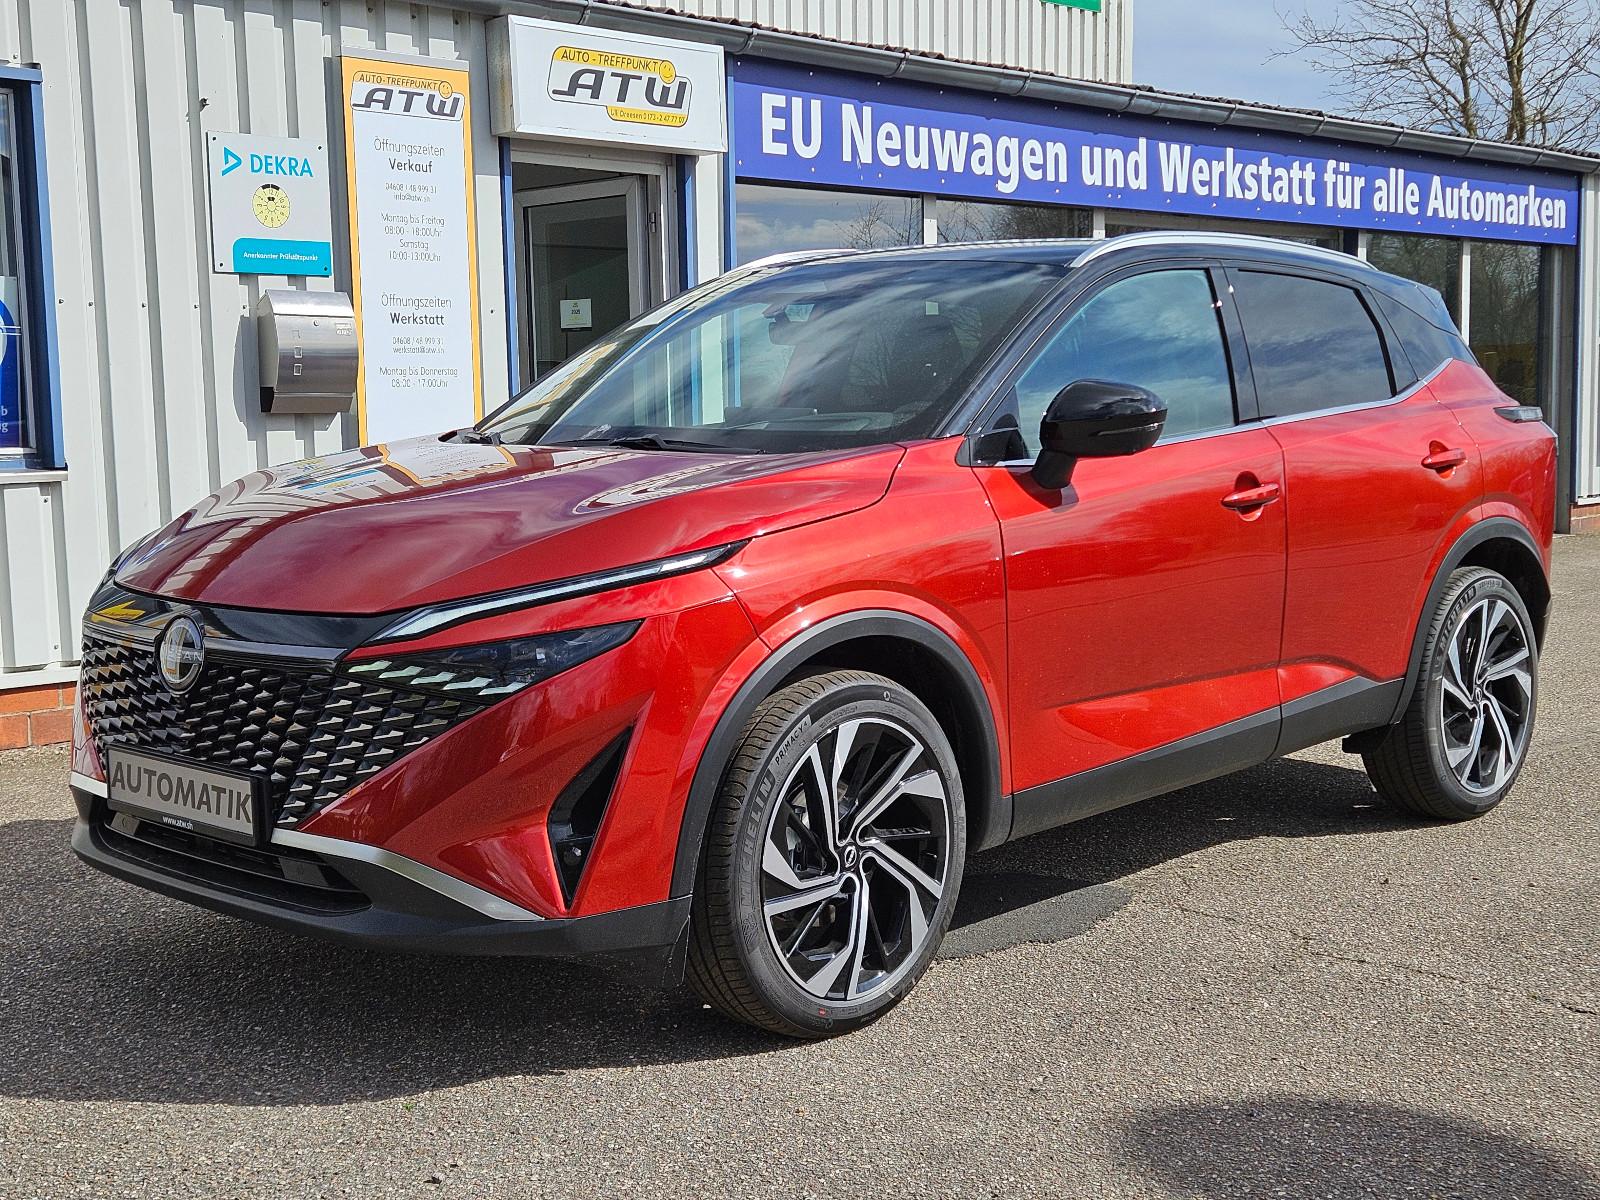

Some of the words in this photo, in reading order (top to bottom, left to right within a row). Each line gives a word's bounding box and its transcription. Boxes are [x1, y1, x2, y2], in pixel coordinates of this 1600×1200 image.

[552, 68, 688, 109] ATW
[352, 87, 461, 118] ATW
[374, 136, 445, 157] Öffnungszeiten
[250, 153, 314, 178] DEKRA
[388, 158, 433, 173] Verkauf
[760, 92, 822, 159] EU
[841, 103, 1068, 194] Neuwagen
[1080, 137, 1148, 190] und
[1158, 142, 1316, 206] Werkstatt
[1324, 159, 1366, 210] für
[1373, 167, 1420, 217] alle
[1426, 174, 1567, 230] Automarken
[380, 211, 408, 226] Montag
[409, 213, 420, 224] bis
[421, 214, 445, 228] Freitag
[399, 238, 429, 252] Samstag
[381, 291, 452, 311] Öffnungszeiten
[389, 312, 445, 326] Werkstatt
[379, 365, 407, 378] Montag
[408, 365, 419, 376] bis
[420, 366, 458, 378] Donnerstag
[111, 760, 253, 825] AUTOMATIK
[162, 815, 195, 831] www.atw.sh
